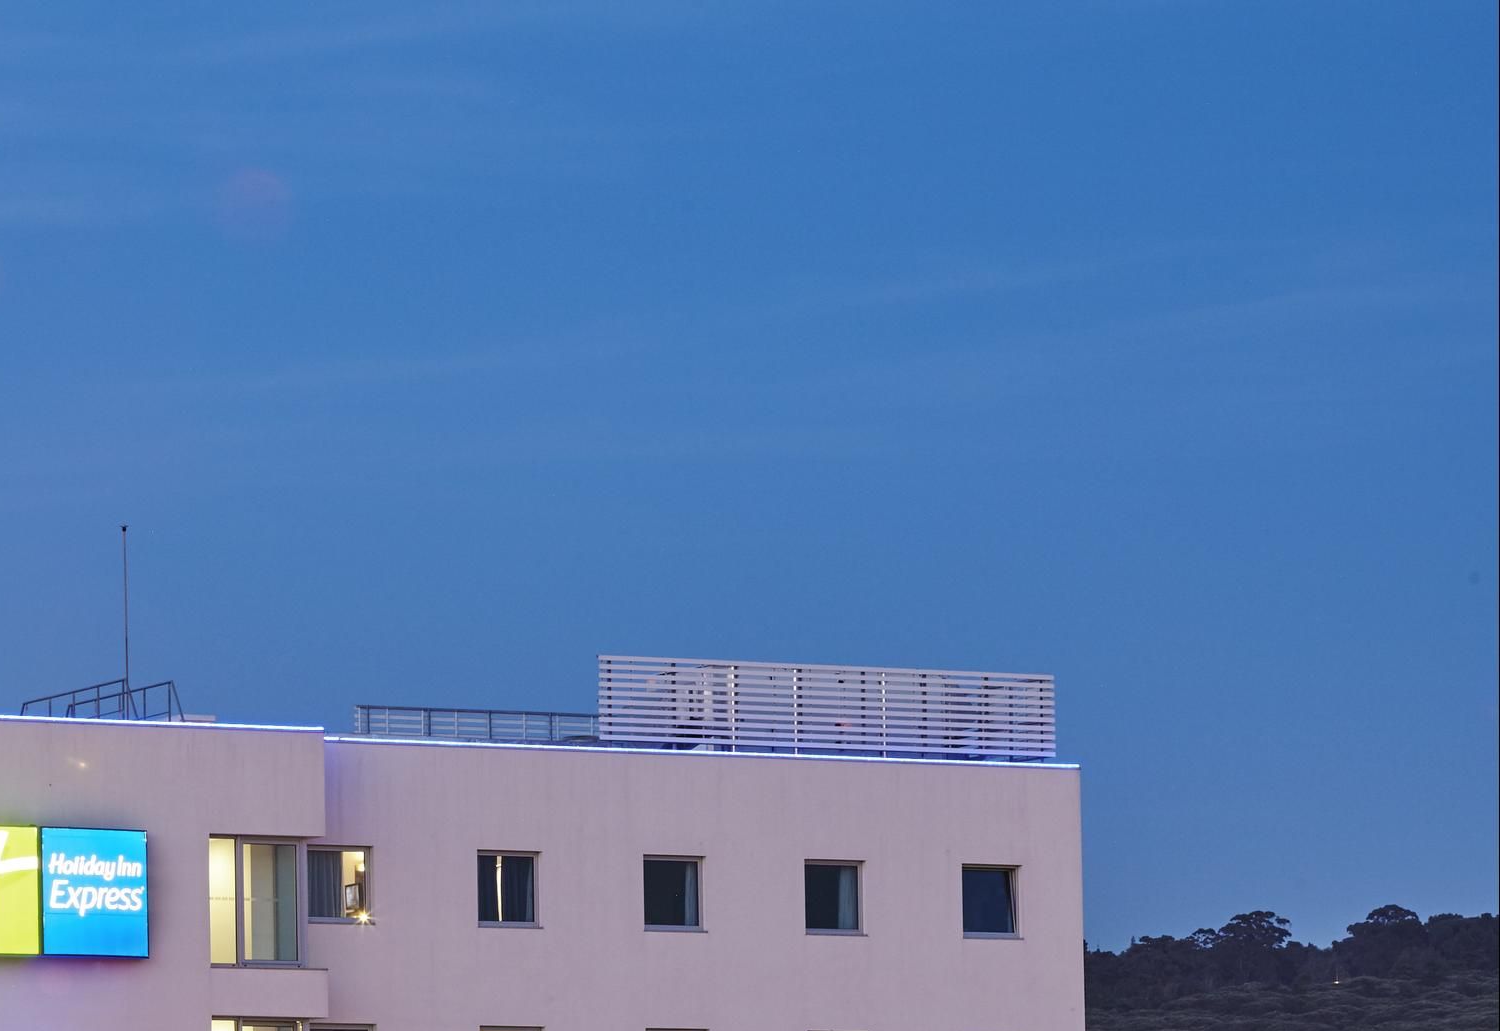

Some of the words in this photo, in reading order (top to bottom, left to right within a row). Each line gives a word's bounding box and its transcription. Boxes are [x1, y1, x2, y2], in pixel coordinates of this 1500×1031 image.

[48, 852, 116, 881] Holiday
[117, 855, 142, 877] Inn
[49, 880, 143, 917] Express
